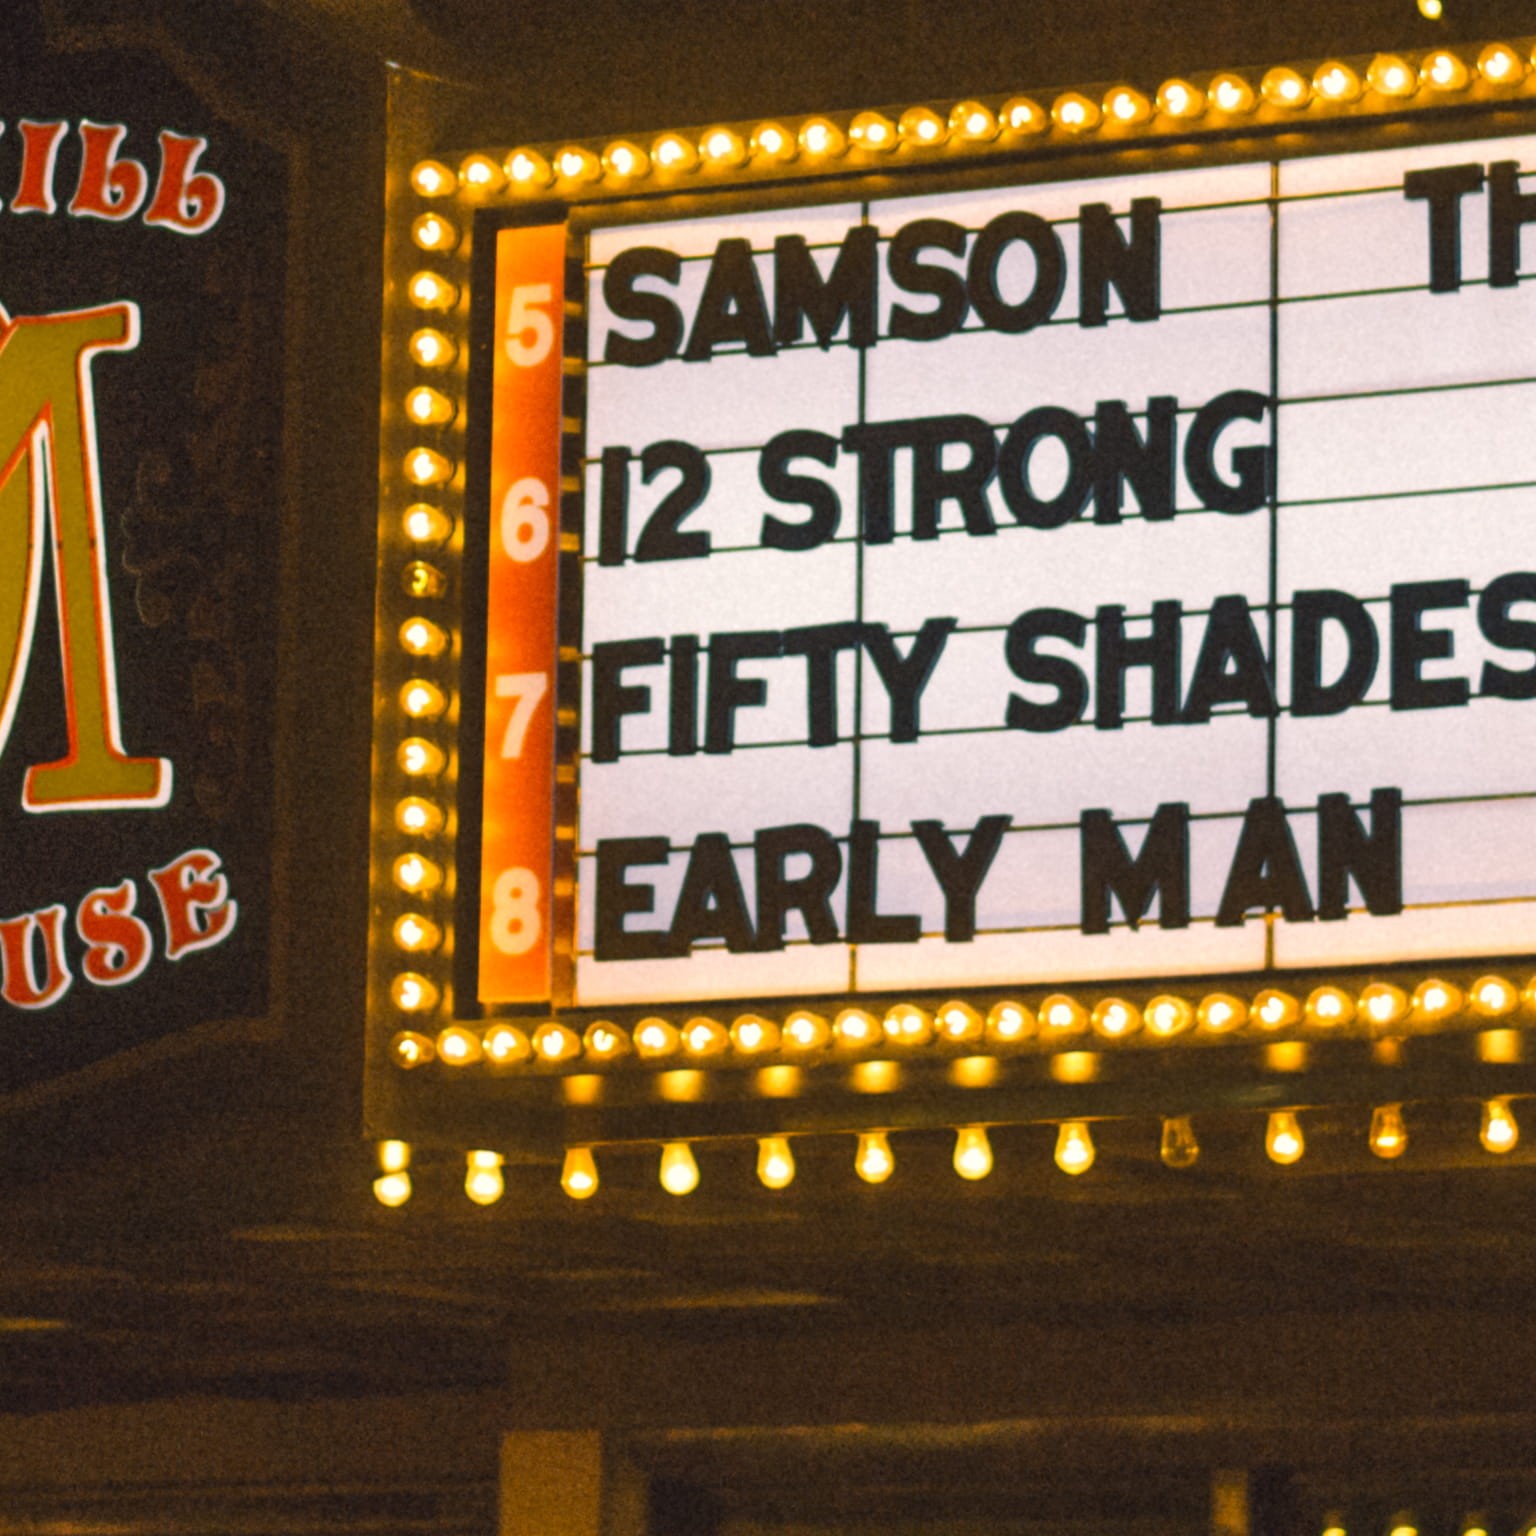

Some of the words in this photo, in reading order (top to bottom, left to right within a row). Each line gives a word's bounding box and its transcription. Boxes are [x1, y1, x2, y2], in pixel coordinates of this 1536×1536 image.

[502, 283, 554, 367] 5
[601, 197, 1162, 368] SAMSON
[499, 475, 552, 563] 6
[599, 439, 713, 567] 12
[758, 390, 1274, 552] STRONG
[495, 672, 549, 760] 7
[591, 617, 959, 763] FIFTY
[490, 867, 544, 956] 8
[594, 814, 1012, 961] EARLY
[1080, 786, 1404, 935] MAN
